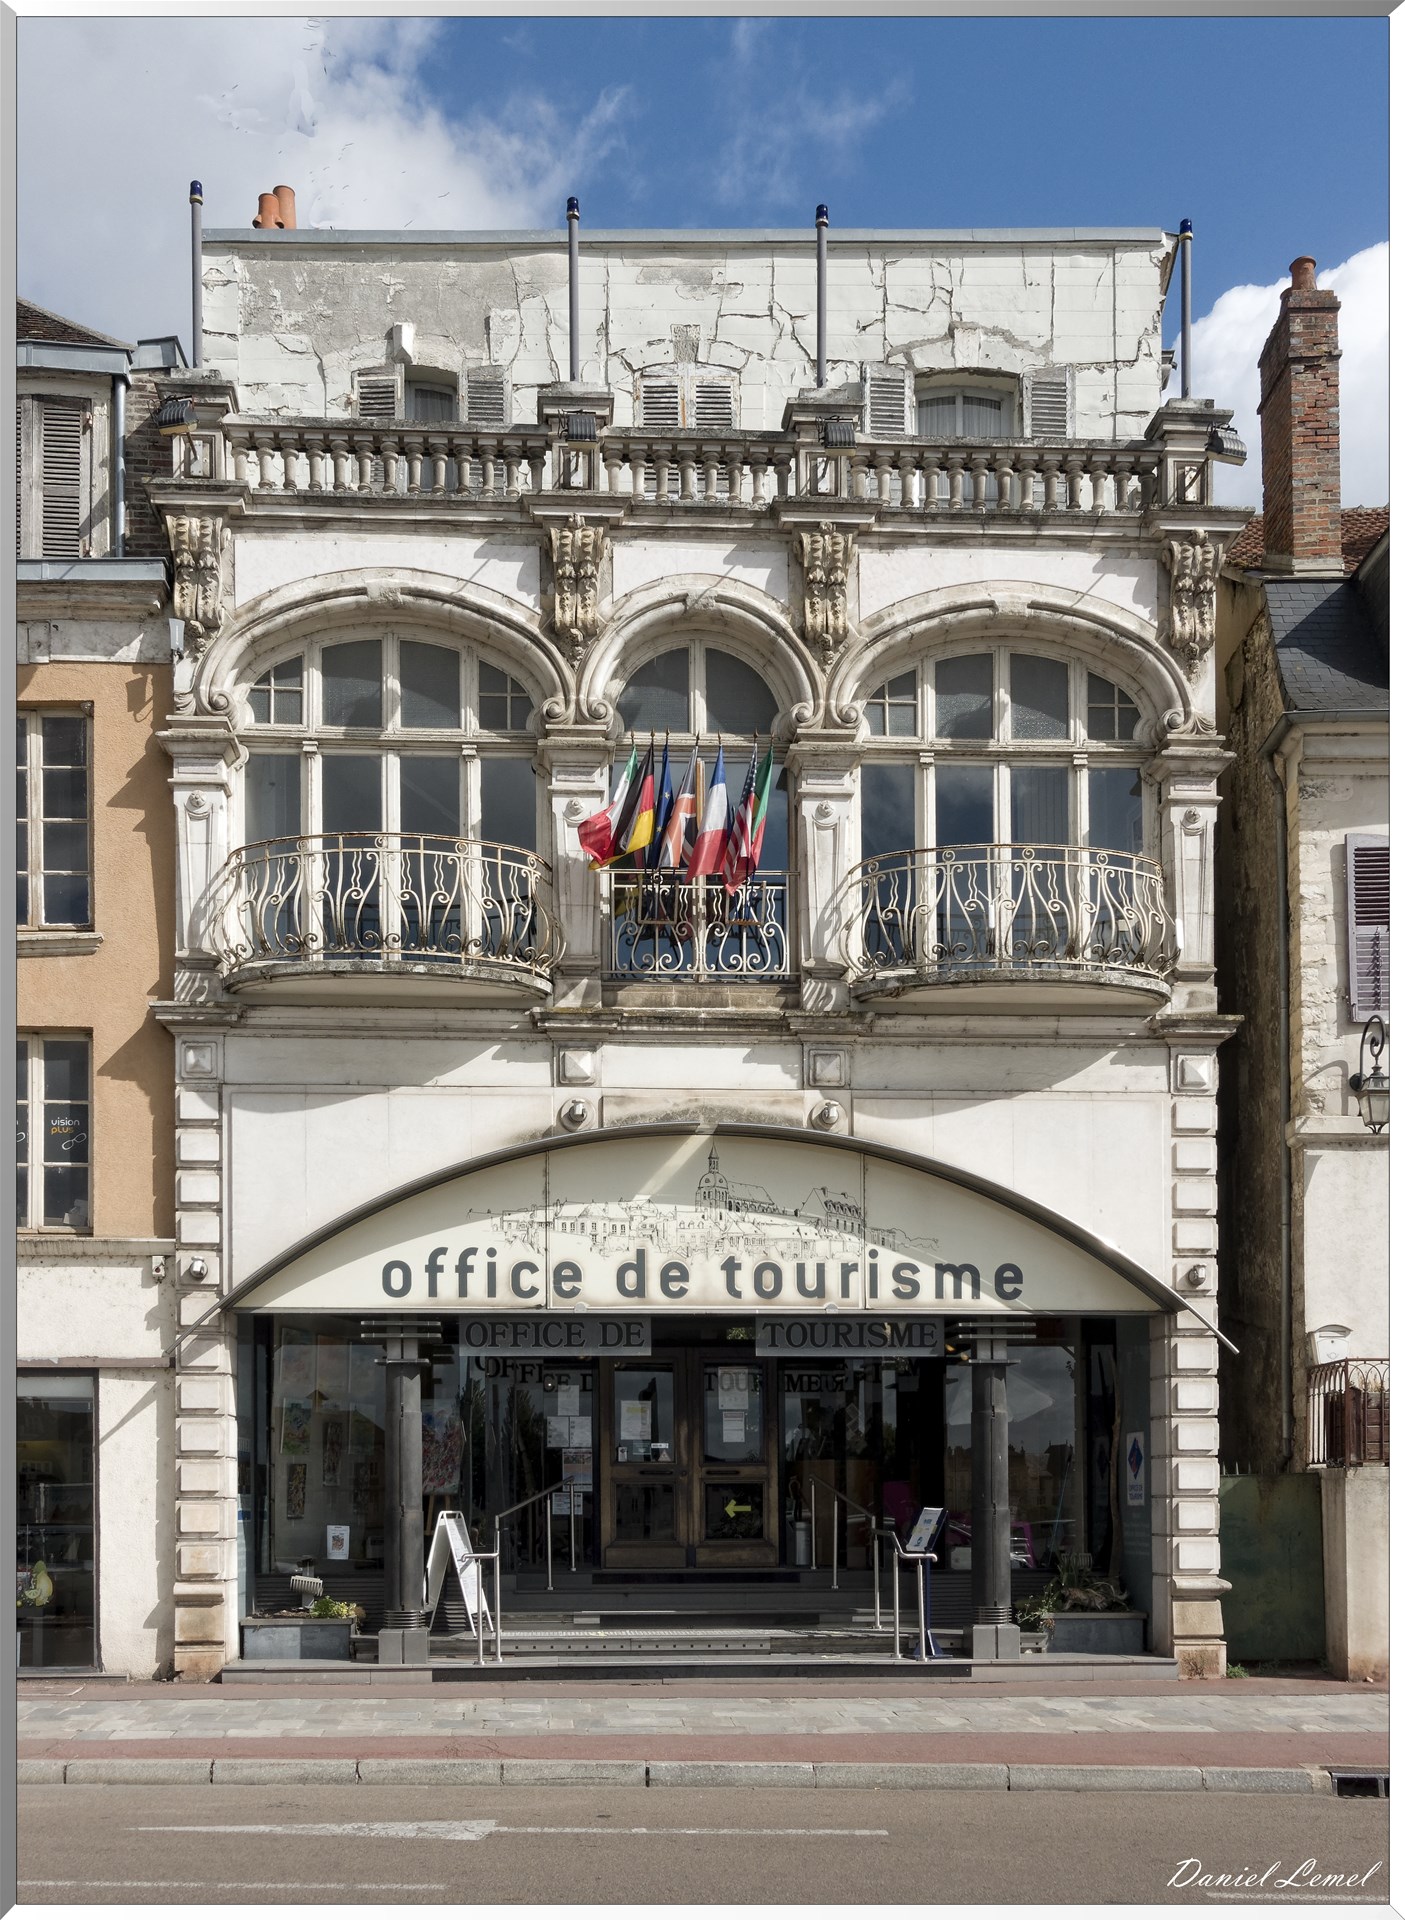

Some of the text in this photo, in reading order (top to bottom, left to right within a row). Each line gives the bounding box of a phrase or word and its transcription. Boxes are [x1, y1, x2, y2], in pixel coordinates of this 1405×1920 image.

[51, 1117, 80, 1126] vision
[382, 1247, 1024, 1300] office de tourisme
[465, 1321, 645, 1348] OFFICE DE
[762, 1322, 938, 1348] TOURISME
